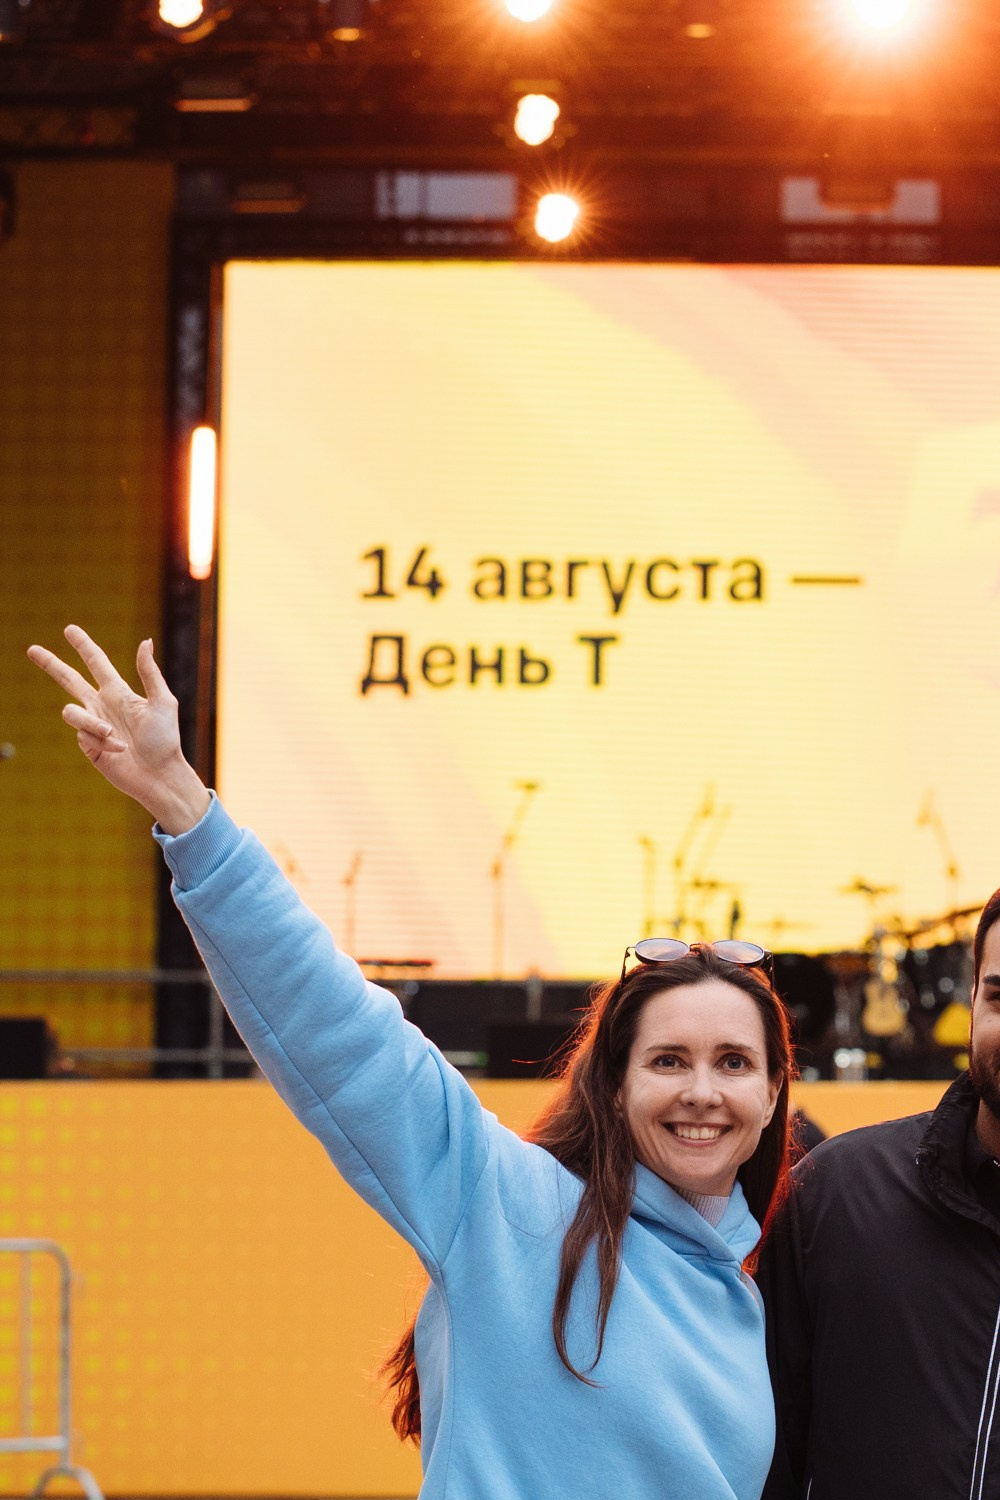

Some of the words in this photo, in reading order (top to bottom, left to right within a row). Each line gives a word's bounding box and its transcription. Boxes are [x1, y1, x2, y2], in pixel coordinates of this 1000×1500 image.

[360, 547, 444, 600] 14
[473, 557, 766, 615] августа
[360, 633, 553, 697] День
[578, 635, 619, 686] Т
